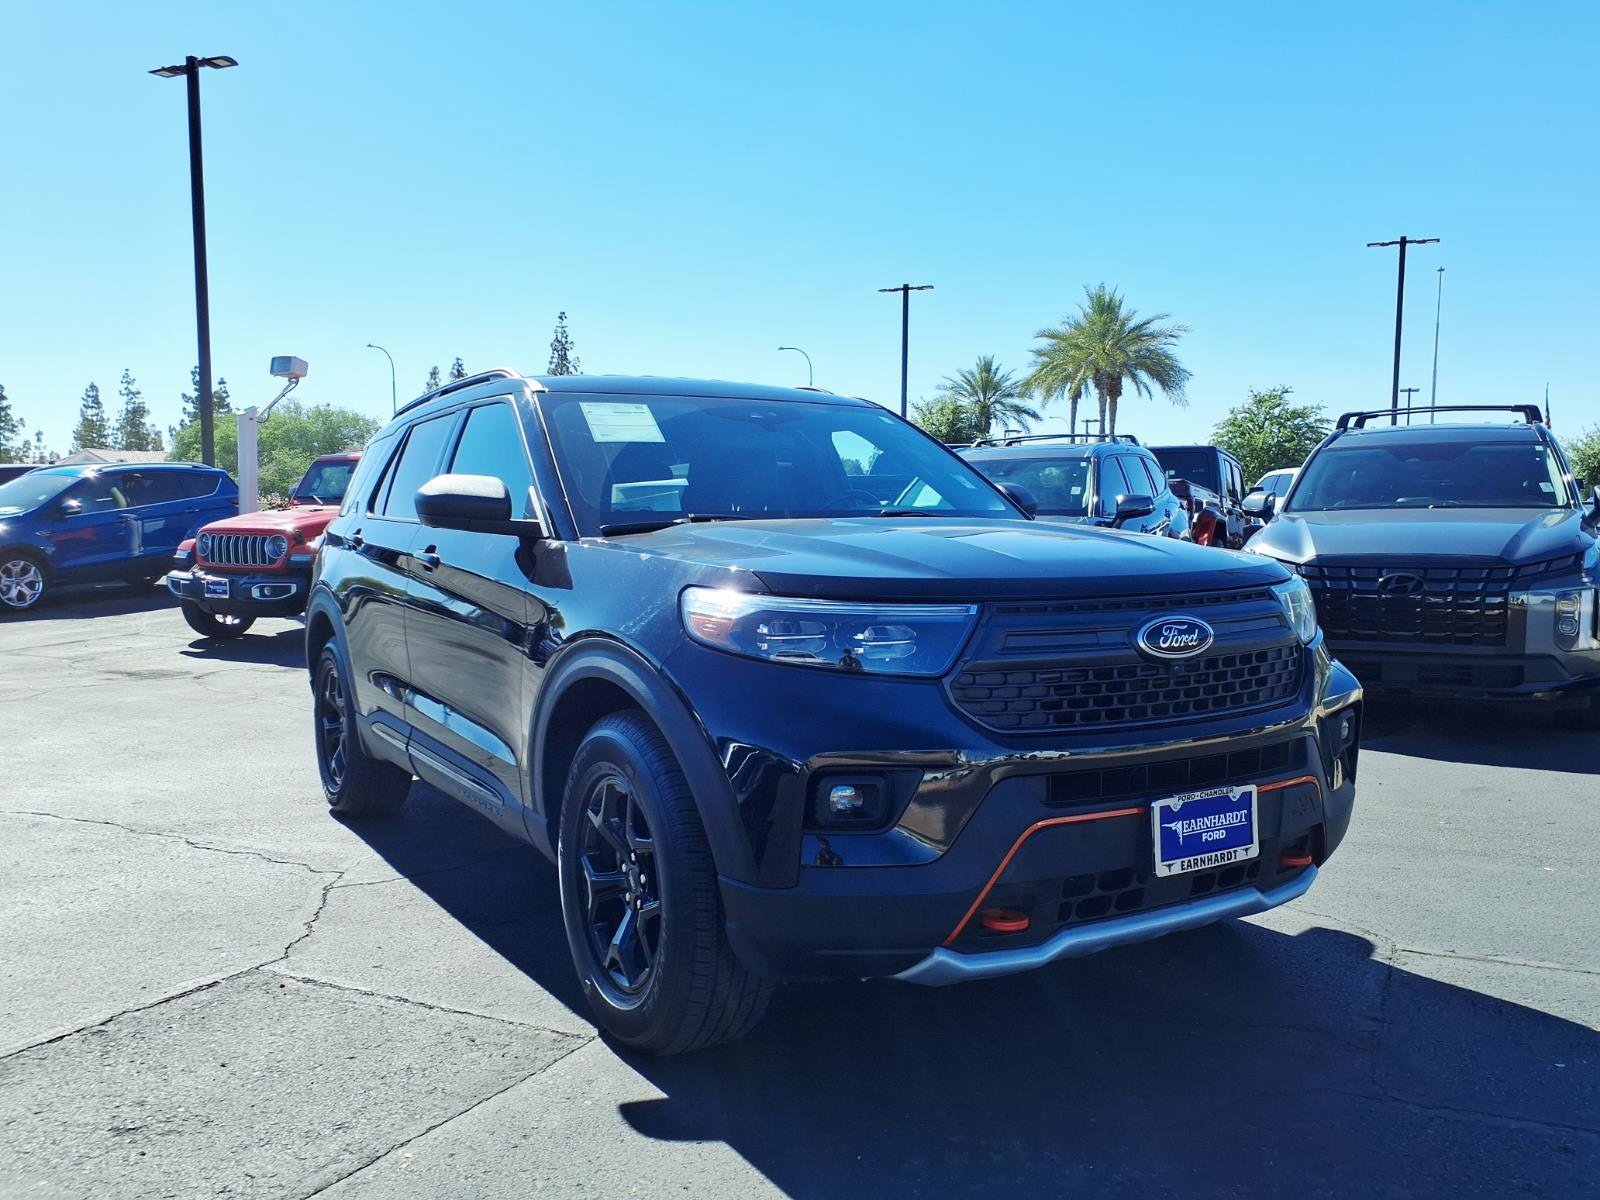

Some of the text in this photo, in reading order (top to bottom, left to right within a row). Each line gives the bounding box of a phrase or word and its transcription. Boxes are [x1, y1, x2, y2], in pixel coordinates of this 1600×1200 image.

[1160, 624, 1199, 648] Ford
[1182, 810, 1247, 833] EARNHARDT
[1202, 830, 1226, 842] FORD
[1180, 850, 1239, 872] EARNHARDT
